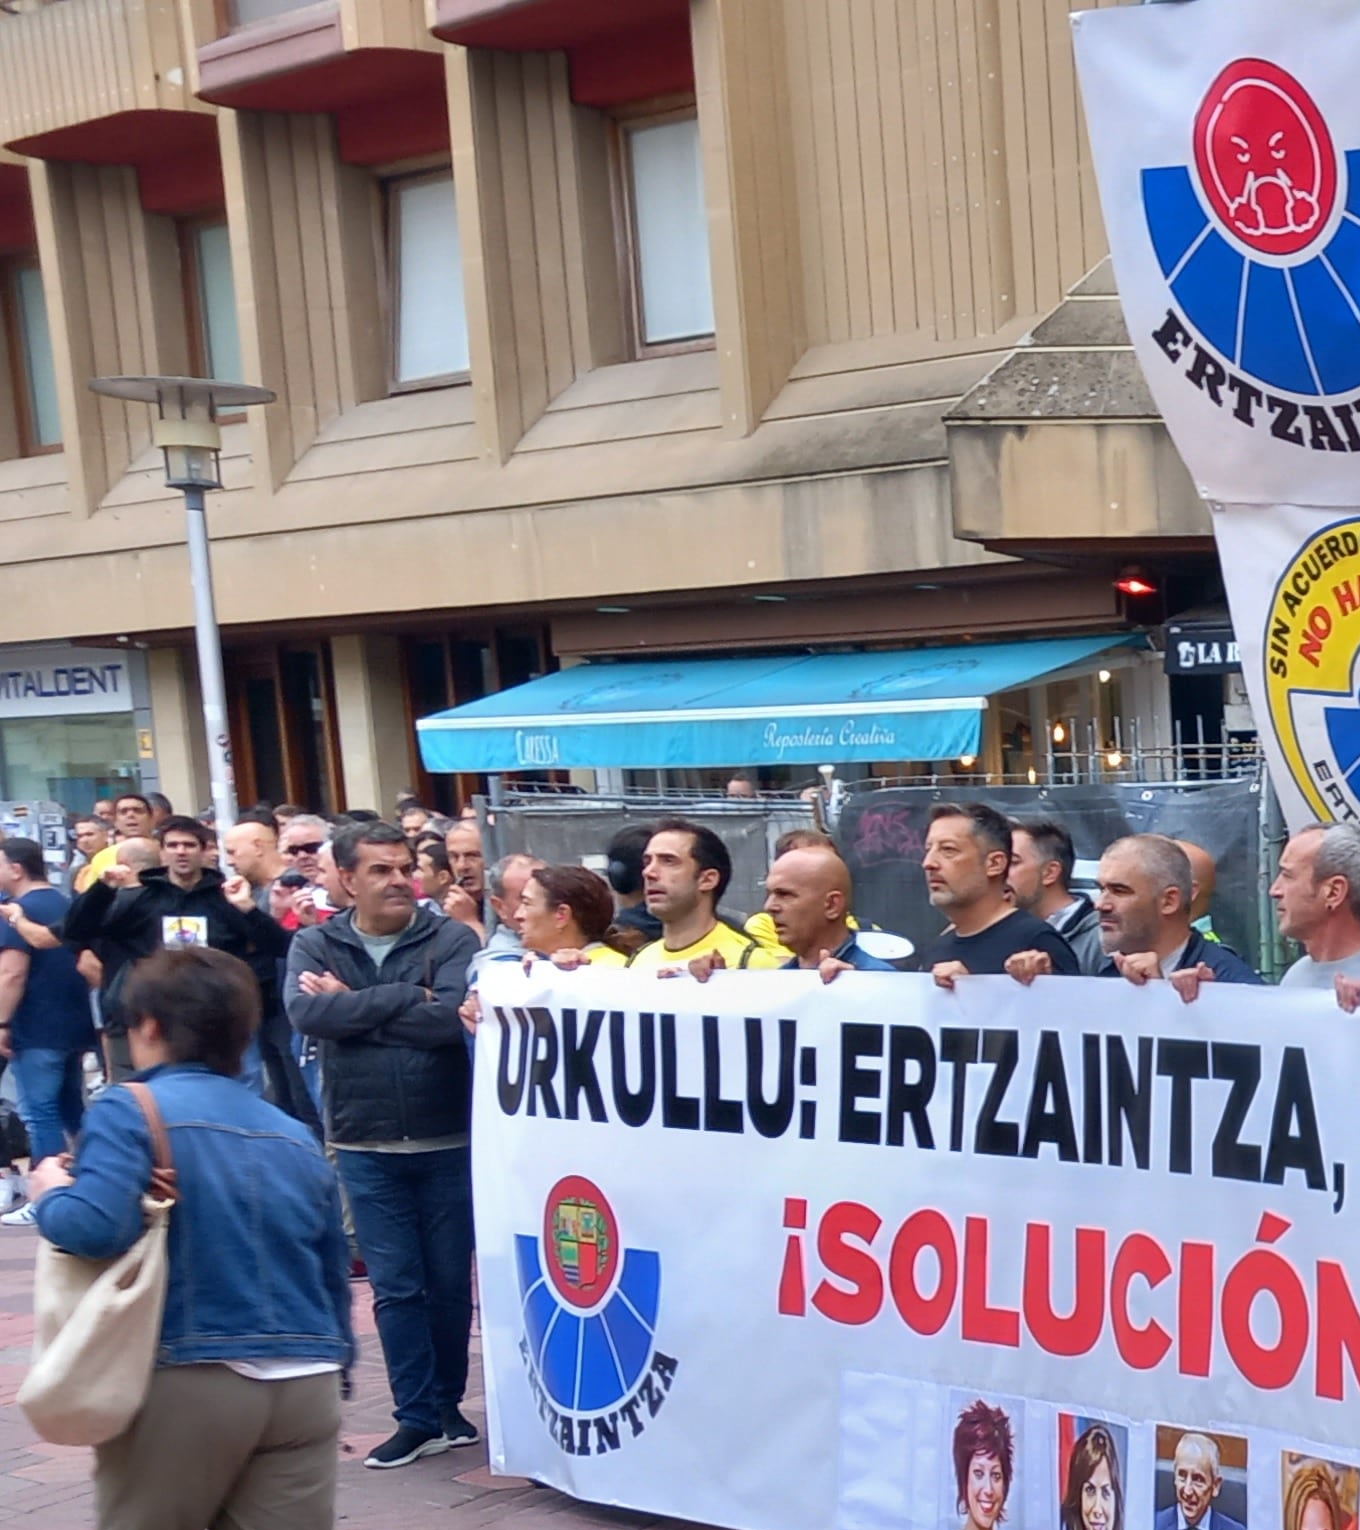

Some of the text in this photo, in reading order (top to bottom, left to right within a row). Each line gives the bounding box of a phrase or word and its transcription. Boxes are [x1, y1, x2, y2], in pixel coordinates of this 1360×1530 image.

[1196, 642, 1223, 664] LA
[1270, 617, 1291, 679] SIN
[1298, 605, 1332, 668] NO
[492, 1006, 817, 1140] URKULLU:
[838, 1022, 1346, 1213] ERTZAINTZA,
